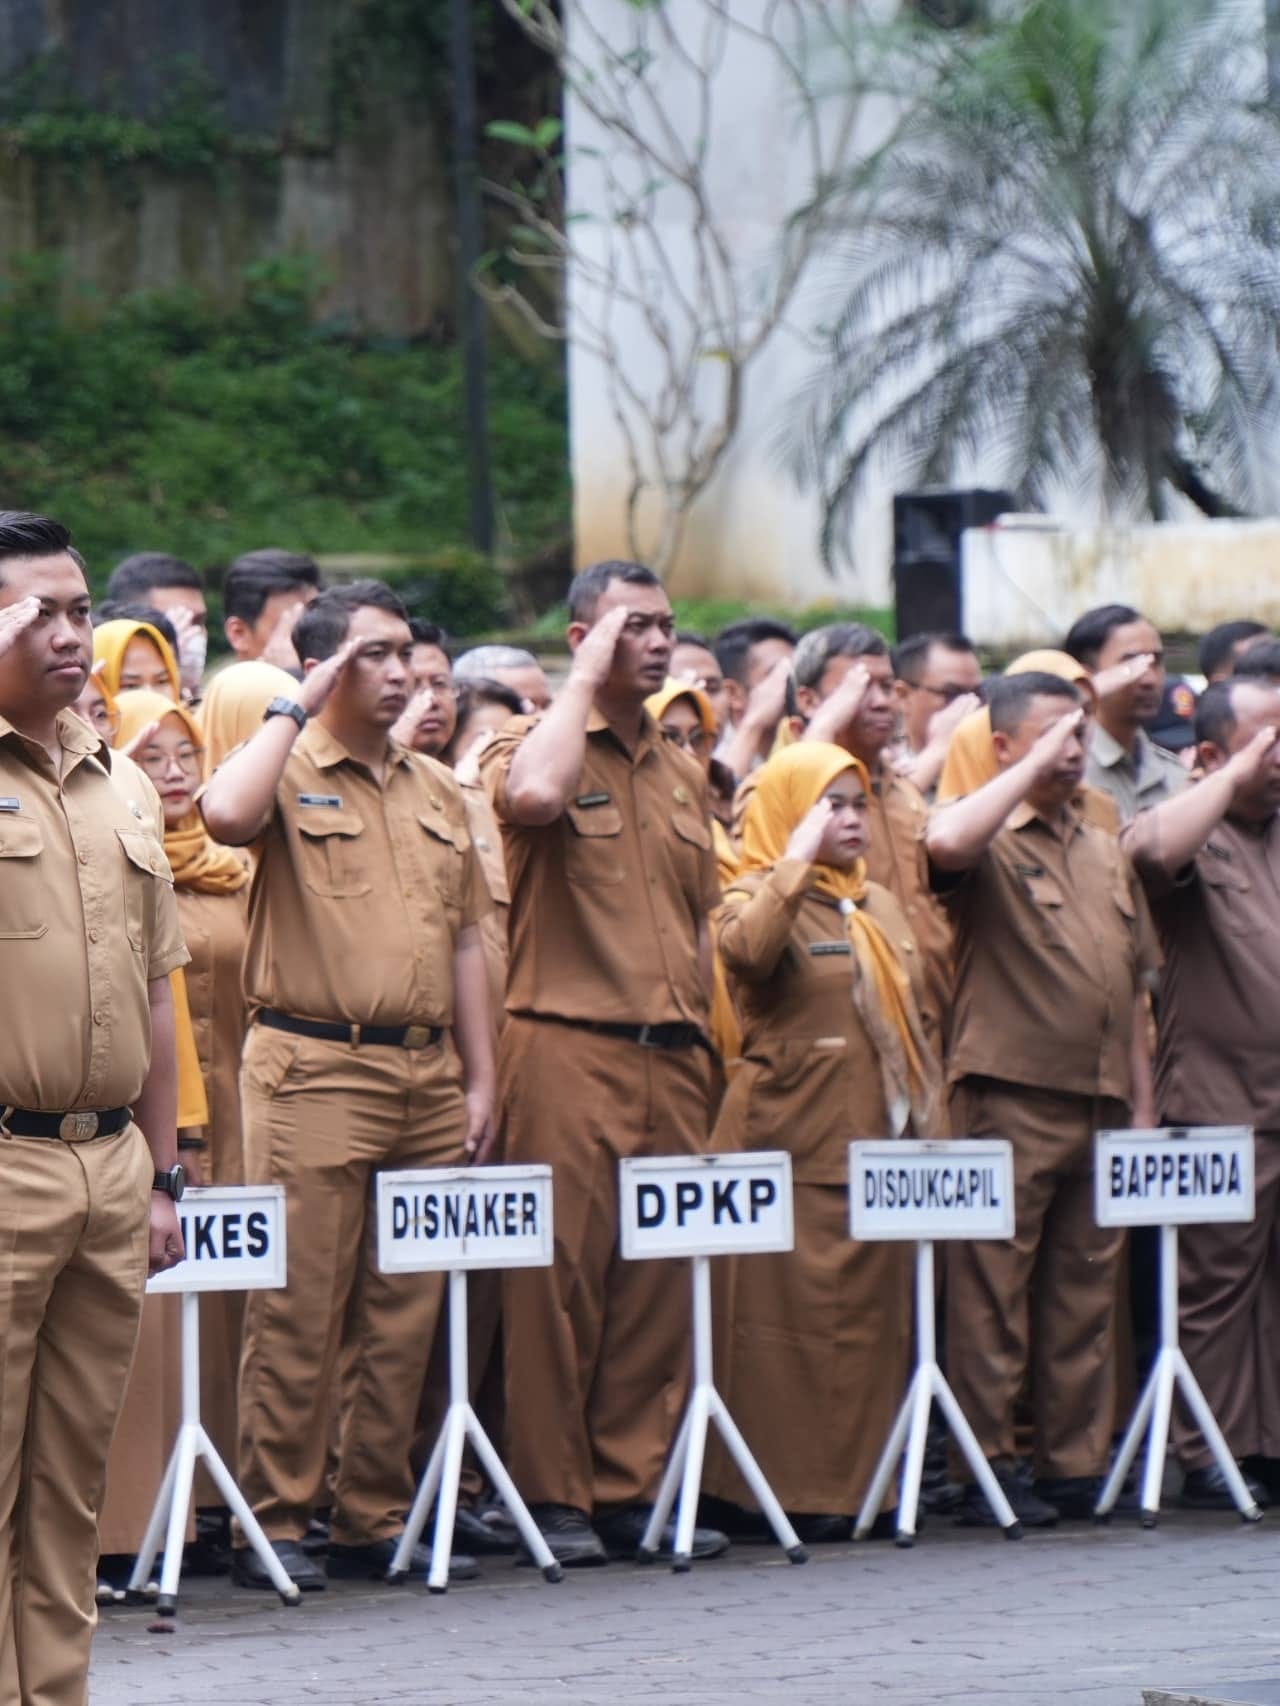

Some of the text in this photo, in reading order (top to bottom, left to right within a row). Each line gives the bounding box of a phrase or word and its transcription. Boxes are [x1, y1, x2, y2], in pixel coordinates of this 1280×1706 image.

[864, 1168, 1000, 1209] DISDUKCAPIL
[1111, 1152, 1241, 1198] BAPPENDA
[393, 1192, 537, 1240] DISNAKER
[636, 1178, 776, 1229] DPKP
